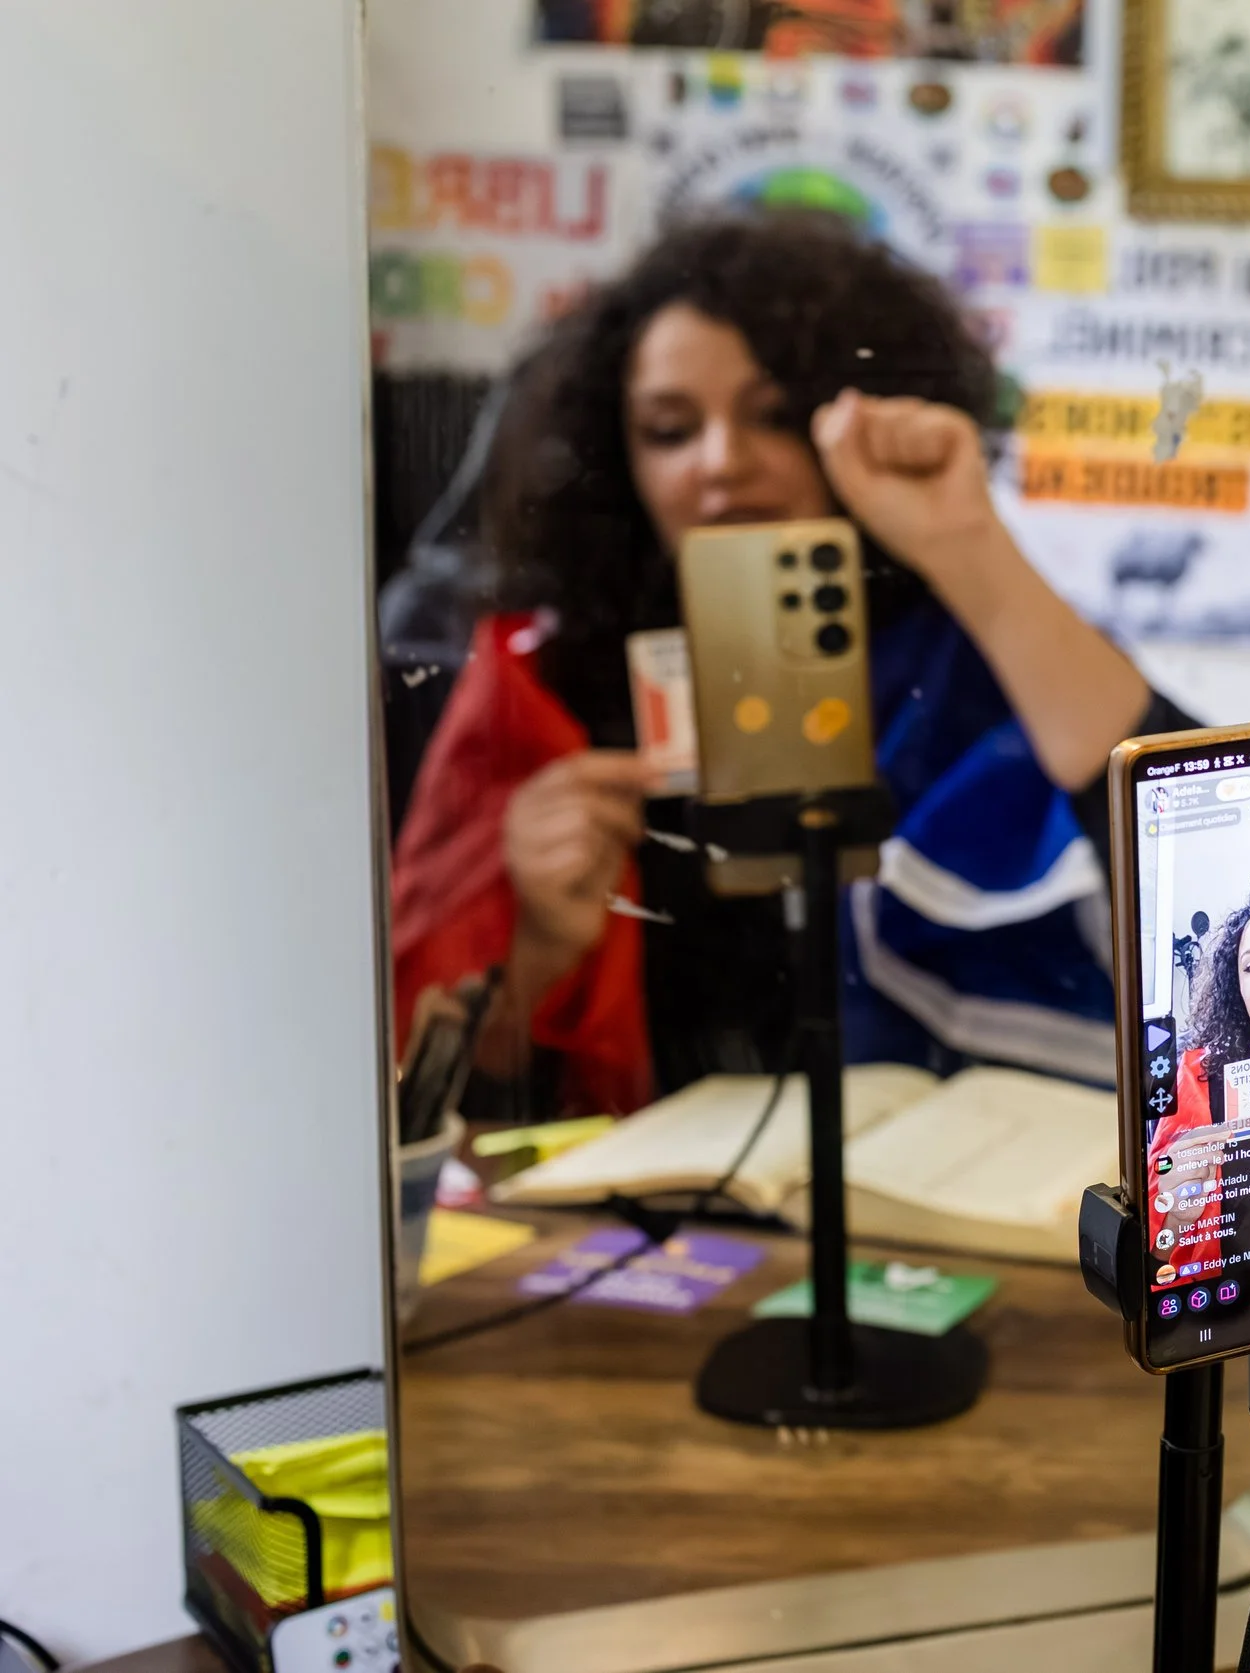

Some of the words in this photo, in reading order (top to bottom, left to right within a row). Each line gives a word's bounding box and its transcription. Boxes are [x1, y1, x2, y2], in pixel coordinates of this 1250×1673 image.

[1183, 759, 1210, 772] 13:59
[1213, 1155, 1222, 1165] le
[1224, 1153, 1234, 1162] tu
[1218, 1174, 1248, 1187] Ariadu
[1178, 1193, 1223, 1210] @Loguito
[1225, 1187, 1238, 1199] toi
[1179, 1223, 1195, 1233] Luc
[1197, 1212, 1236, 1229] MARTIN
[1179, 1233, 1203, 1247] Salut
[1205, 1231, 1211, 1240] à
[1203, 1257, 1227, 1271] Eddy
[1229, 1254, 1241, 1264] de
